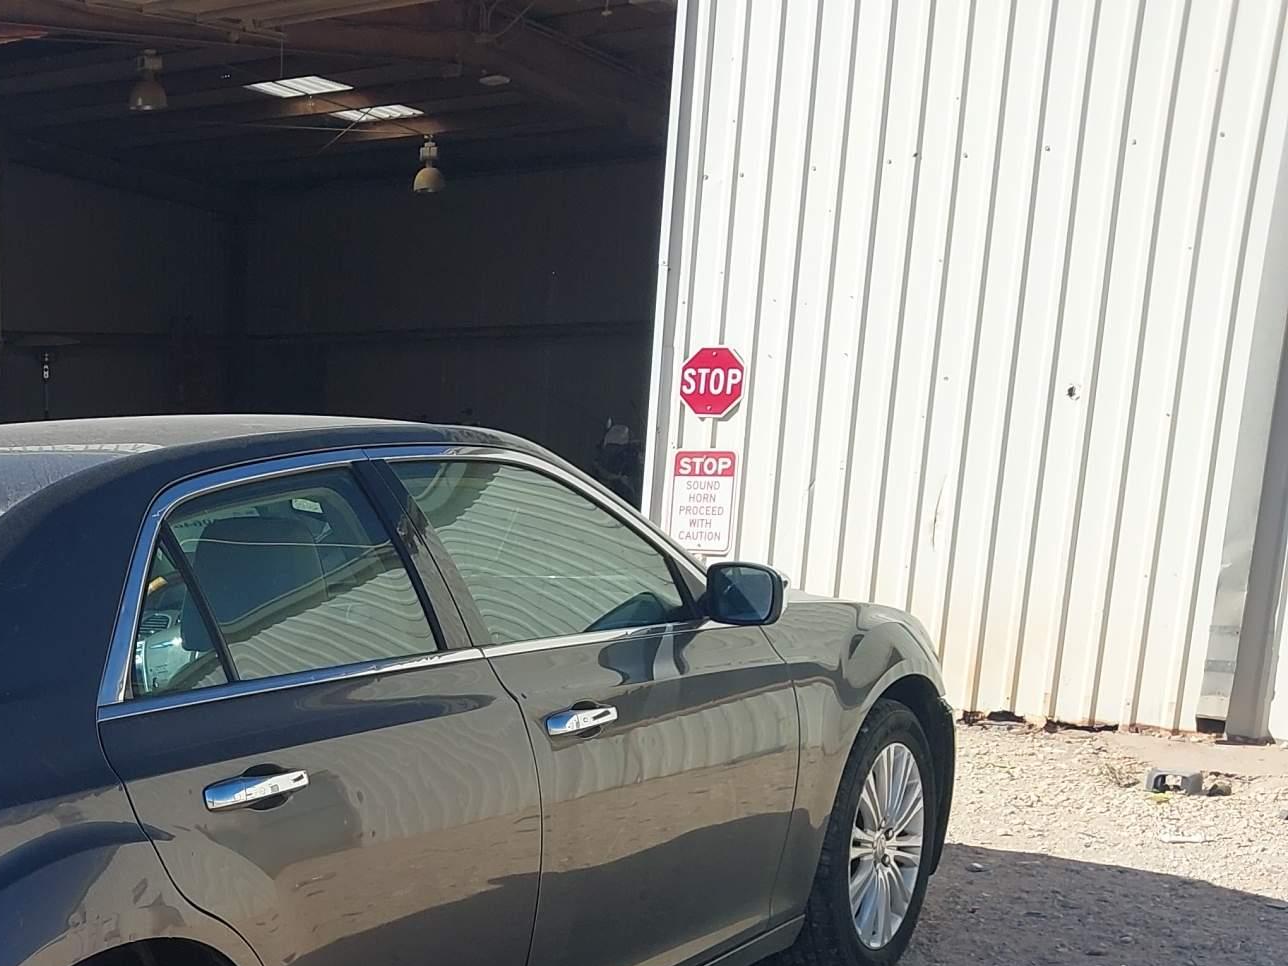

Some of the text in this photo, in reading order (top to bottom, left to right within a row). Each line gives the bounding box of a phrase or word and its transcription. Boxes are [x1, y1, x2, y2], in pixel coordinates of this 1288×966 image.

[682, 368, 742, 395] STOP
[679, 457, 732, 475] STOP
[686, 480, 720, 490] SOUND
[688, 493, 716, 503] HORN
[679, 506, 724, 516] PROCEED
[689, 519, 712, 529] WITH
[678, 531, 721, 541] CAUTION
